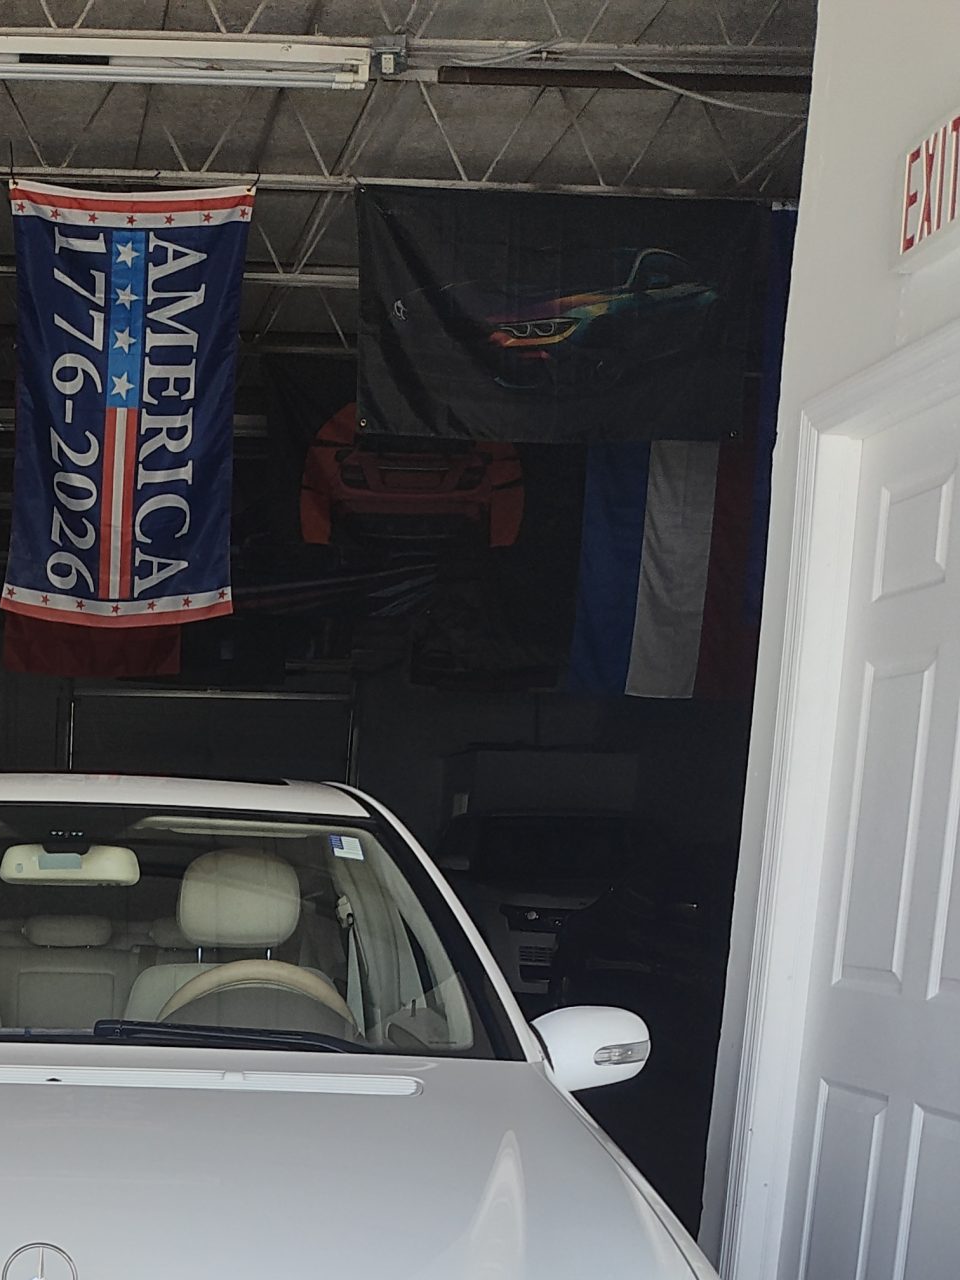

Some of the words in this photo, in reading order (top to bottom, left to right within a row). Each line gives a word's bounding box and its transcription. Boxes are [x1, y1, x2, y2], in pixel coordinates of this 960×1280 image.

[900, 115, 960, 254] EXIT
[45, 226, 106, 593] 1776-2026
[133, 231, 207, 598] AMERICA
